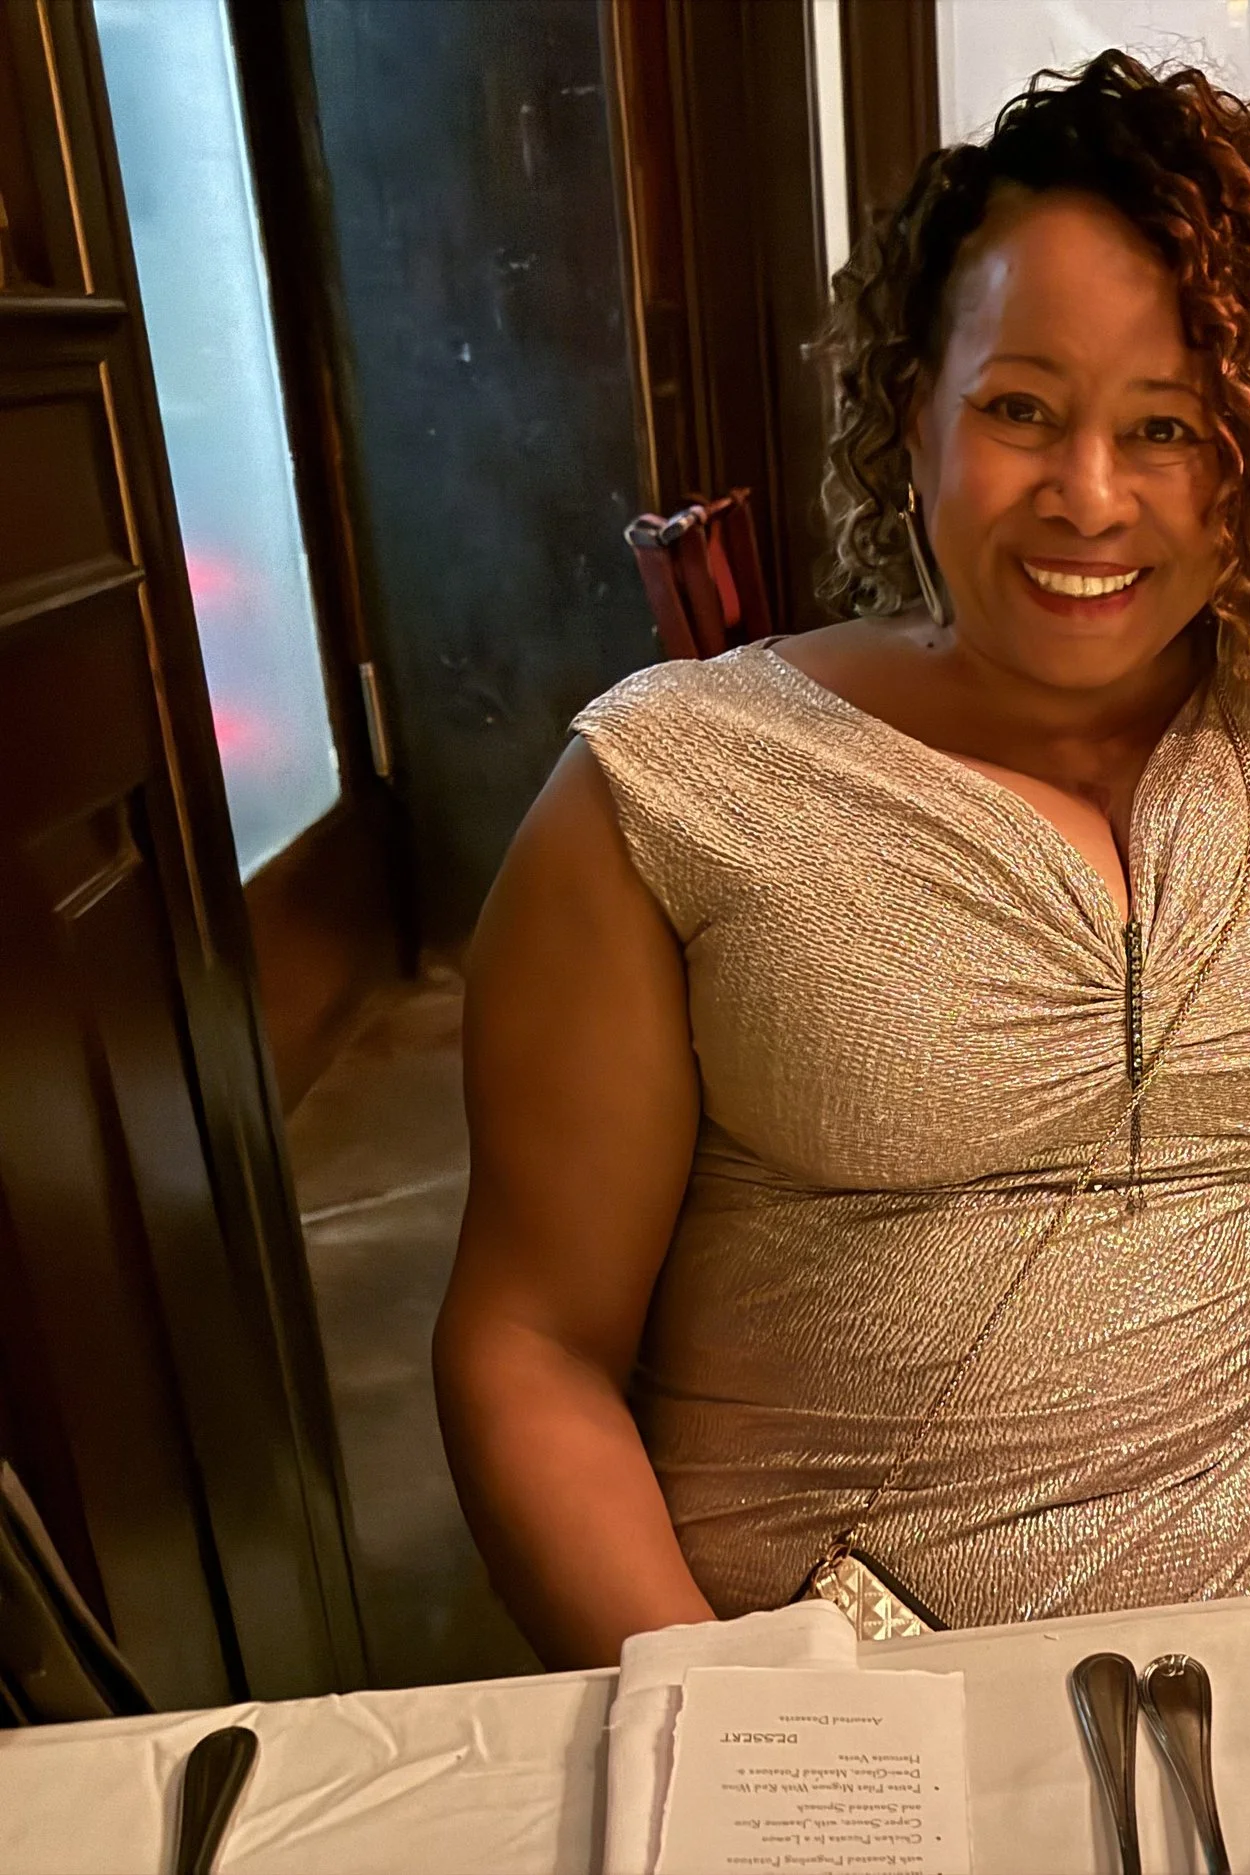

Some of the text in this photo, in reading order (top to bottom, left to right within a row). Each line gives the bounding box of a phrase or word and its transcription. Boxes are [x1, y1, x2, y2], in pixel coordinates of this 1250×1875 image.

[778, 1715, 883, 1726] Assorted Desserts
[720, 1732, 798, 1744] DESSERT
[803, 1769, 847, 1779] Mashed
[755, 1783, 778, 1794] Red
[812, 1782, 854, 1793] Mignon
[888, 1783, 921, 1794] Petite
[902, 1805, 922, 1814] and
[814, 1820, 837, 1828] with
[885, 1817, 922, 1829] Caper
[762, 1834, 800, 1845] Lemon
[874, 1834, 922, 1845] Chicken
